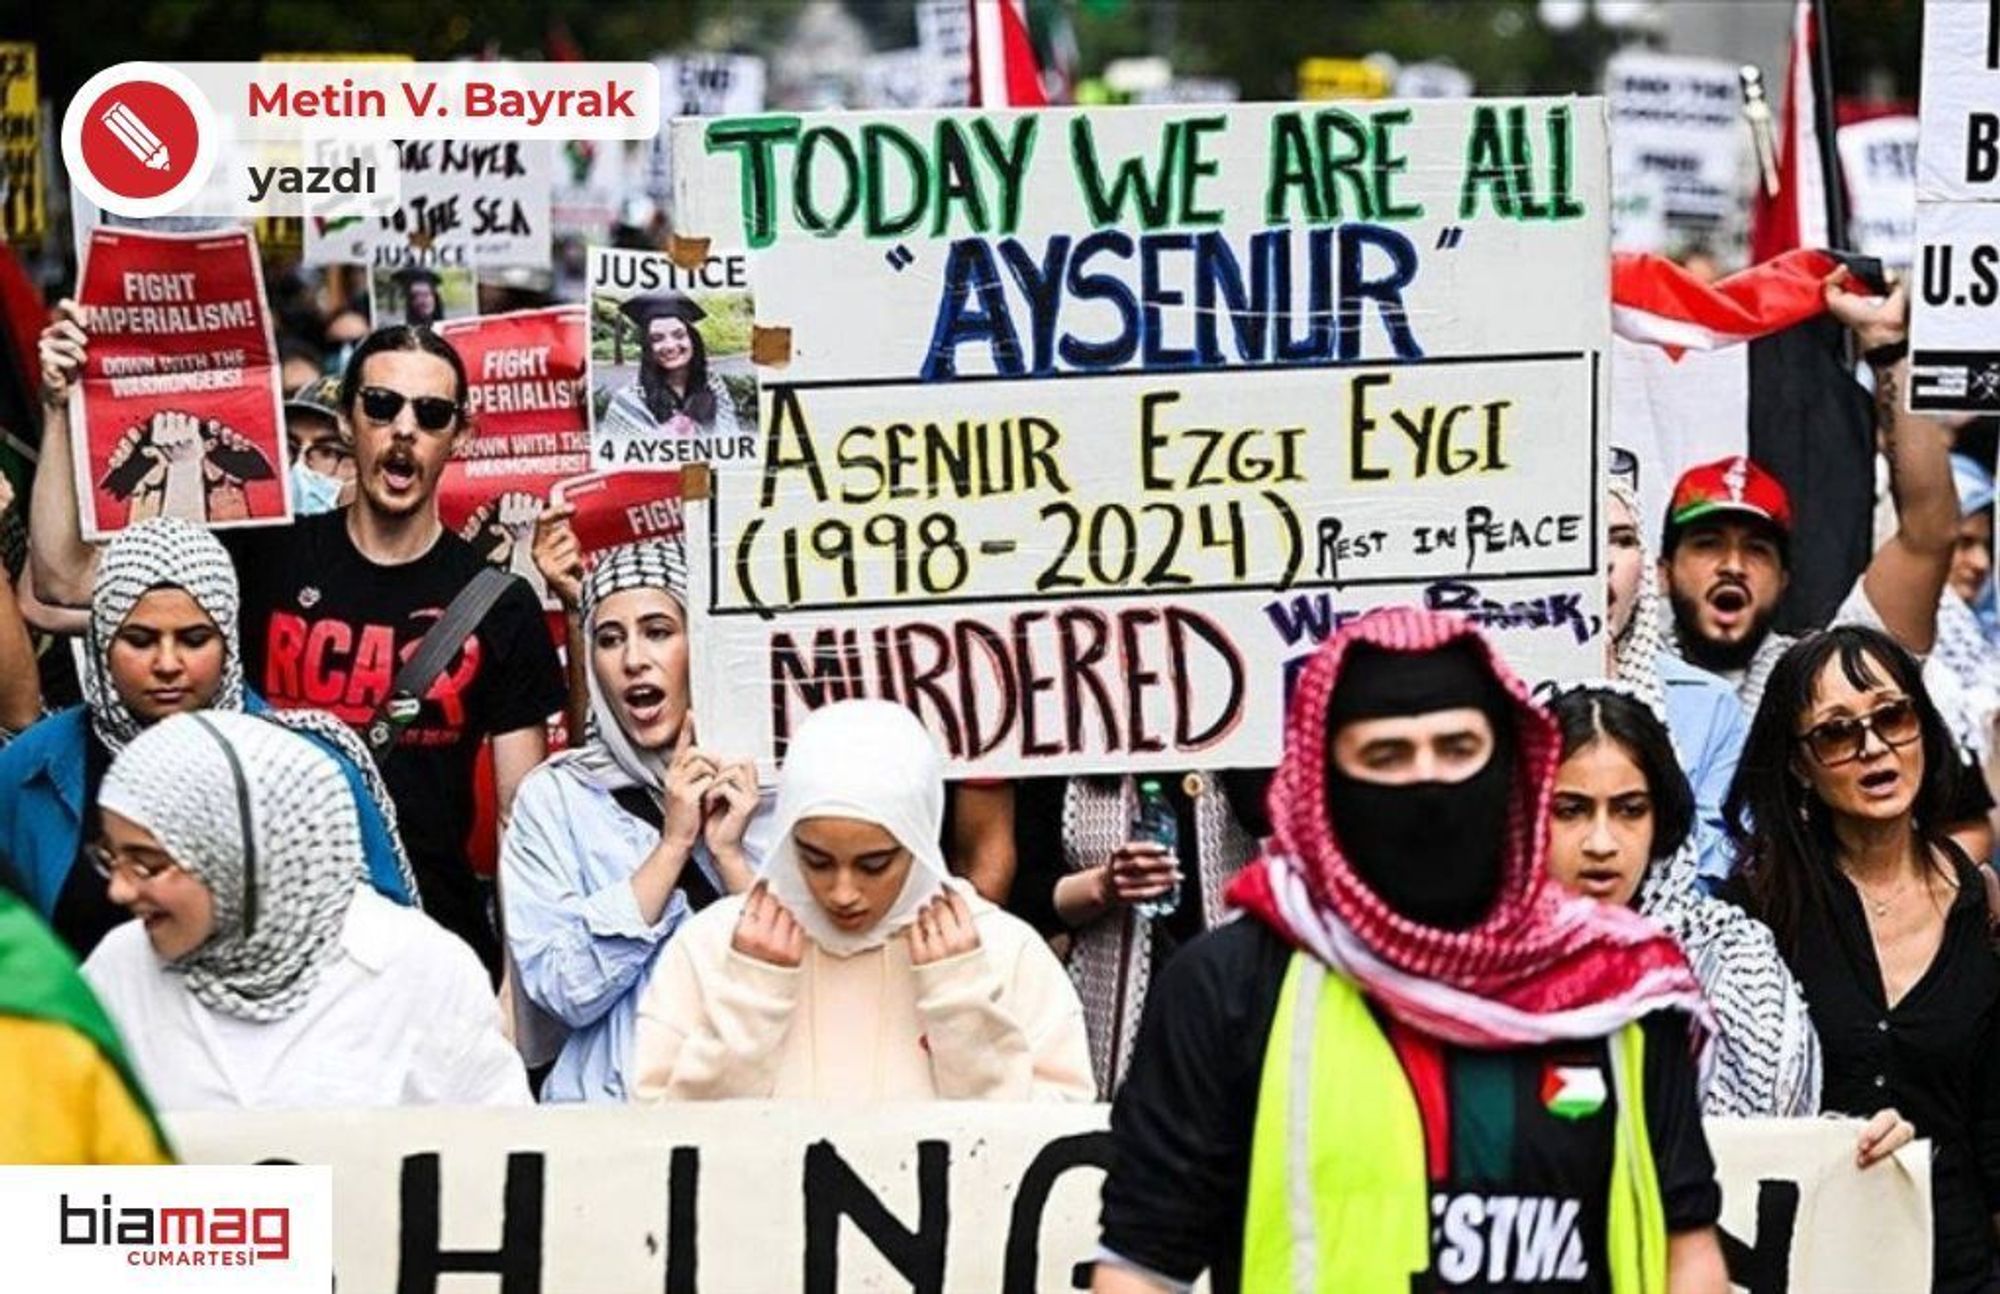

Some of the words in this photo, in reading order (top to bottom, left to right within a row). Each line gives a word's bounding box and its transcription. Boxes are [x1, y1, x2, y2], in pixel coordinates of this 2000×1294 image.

[706, 113, 1038, 249] TODAY
[1070, 112, 1229, 229] WE
[1265, 107, 1425, 222] ARE
[1457, 103, 1586, 220] ALL
[472, 195, 531, 237] SEA
[123, 271, 196, 302] FIGHT
[595, 253, 748, 290] JUSTICE
[84, 299, 256, 335] MPERIALISM!
[483, 345, 551, 379] FIGHT
[600, 440, 616, 462] 4
[624, 436, 757, 463] AYSENUR
[760, 384, 1072, 507] ASENUR
[1140, 389, 1307, 491] EZGI
[1350, 373, 1512, 481] EYGI
[626, 496, 682, 535] FIGH
[1315, 517, 1388, 590] REST
[1413, 526, 1458, 555] IN
[1466, 505, 1583, 571] PEACE
[265, 611, 396, 707] RCA
